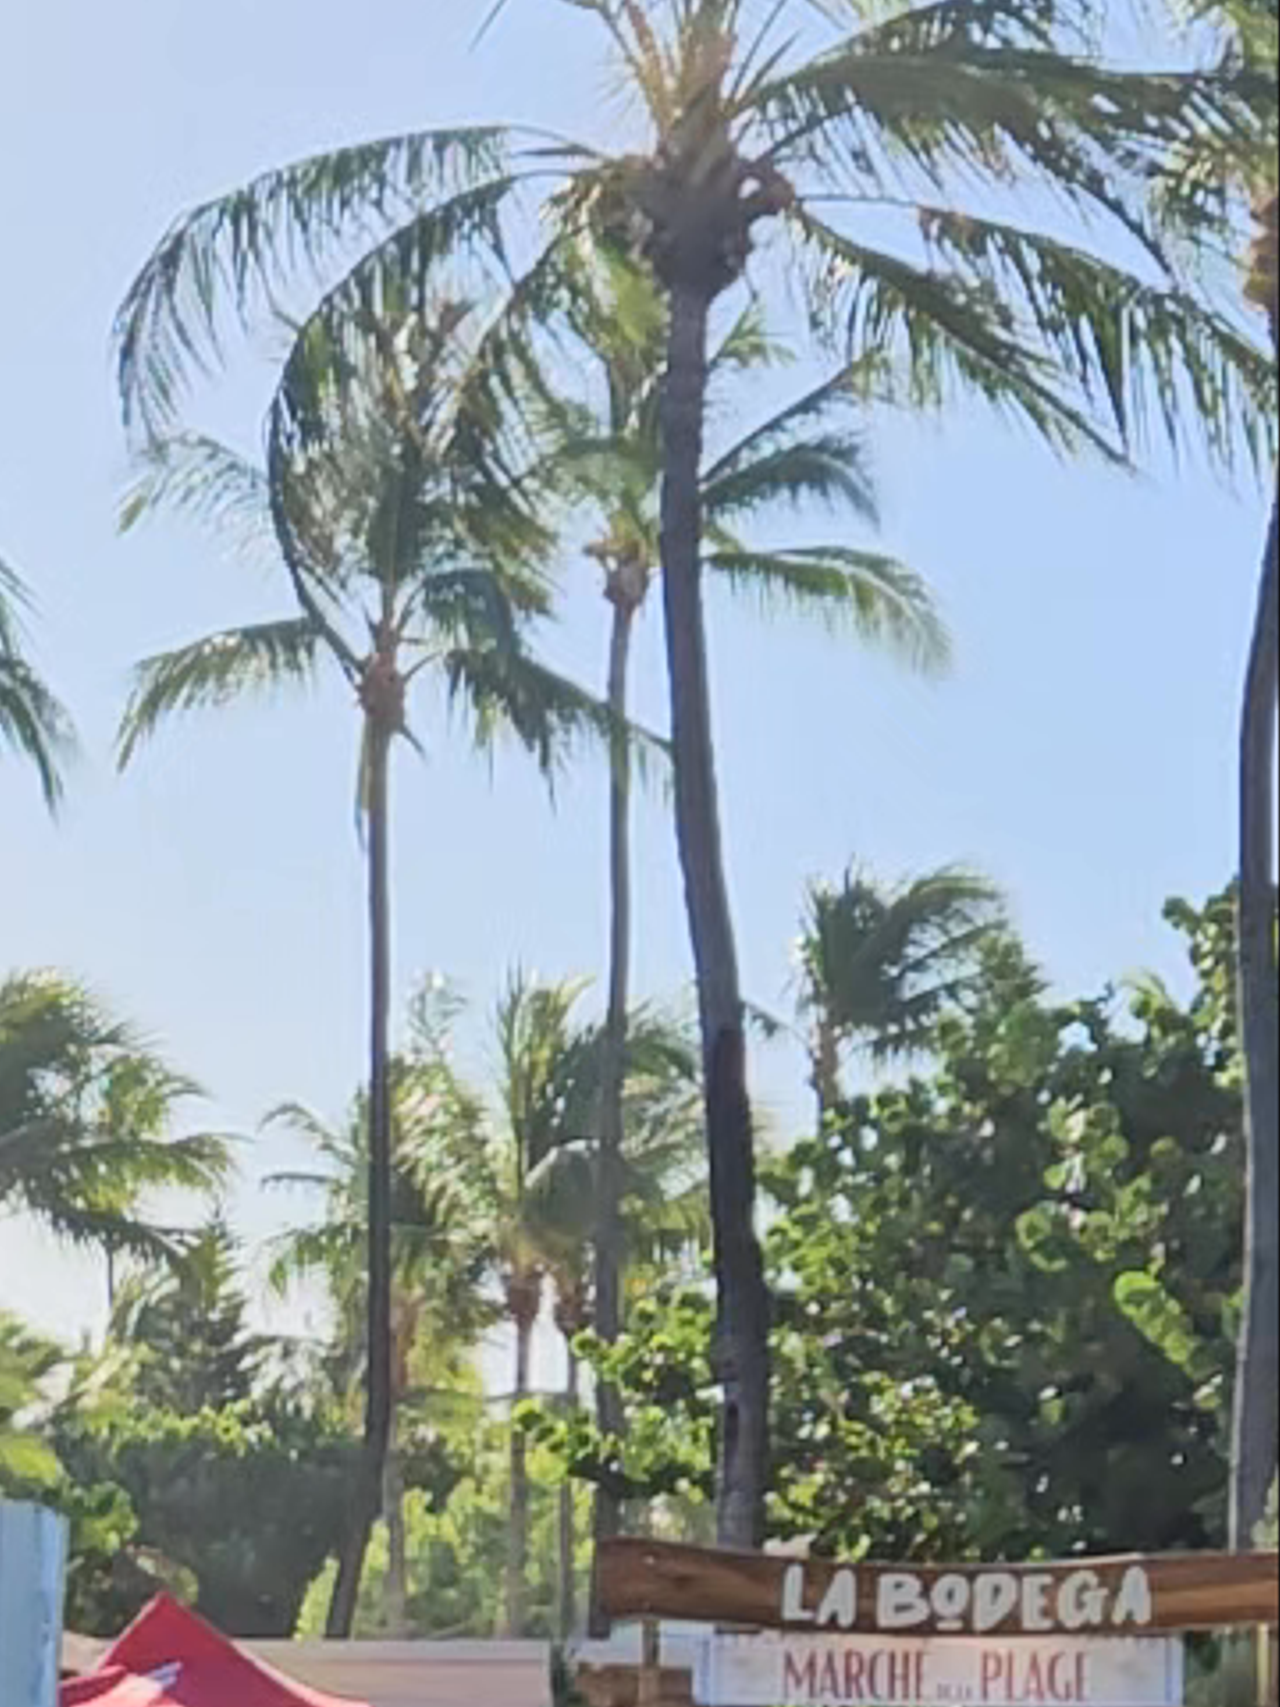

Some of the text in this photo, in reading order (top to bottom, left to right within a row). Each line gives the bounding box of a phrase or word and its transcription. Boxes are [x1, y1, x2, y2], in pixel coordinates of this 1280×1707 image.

[781, 1563, 1153, 1632] LA BODEGA
[980, 1649, 1088, 1701] PLAGE
